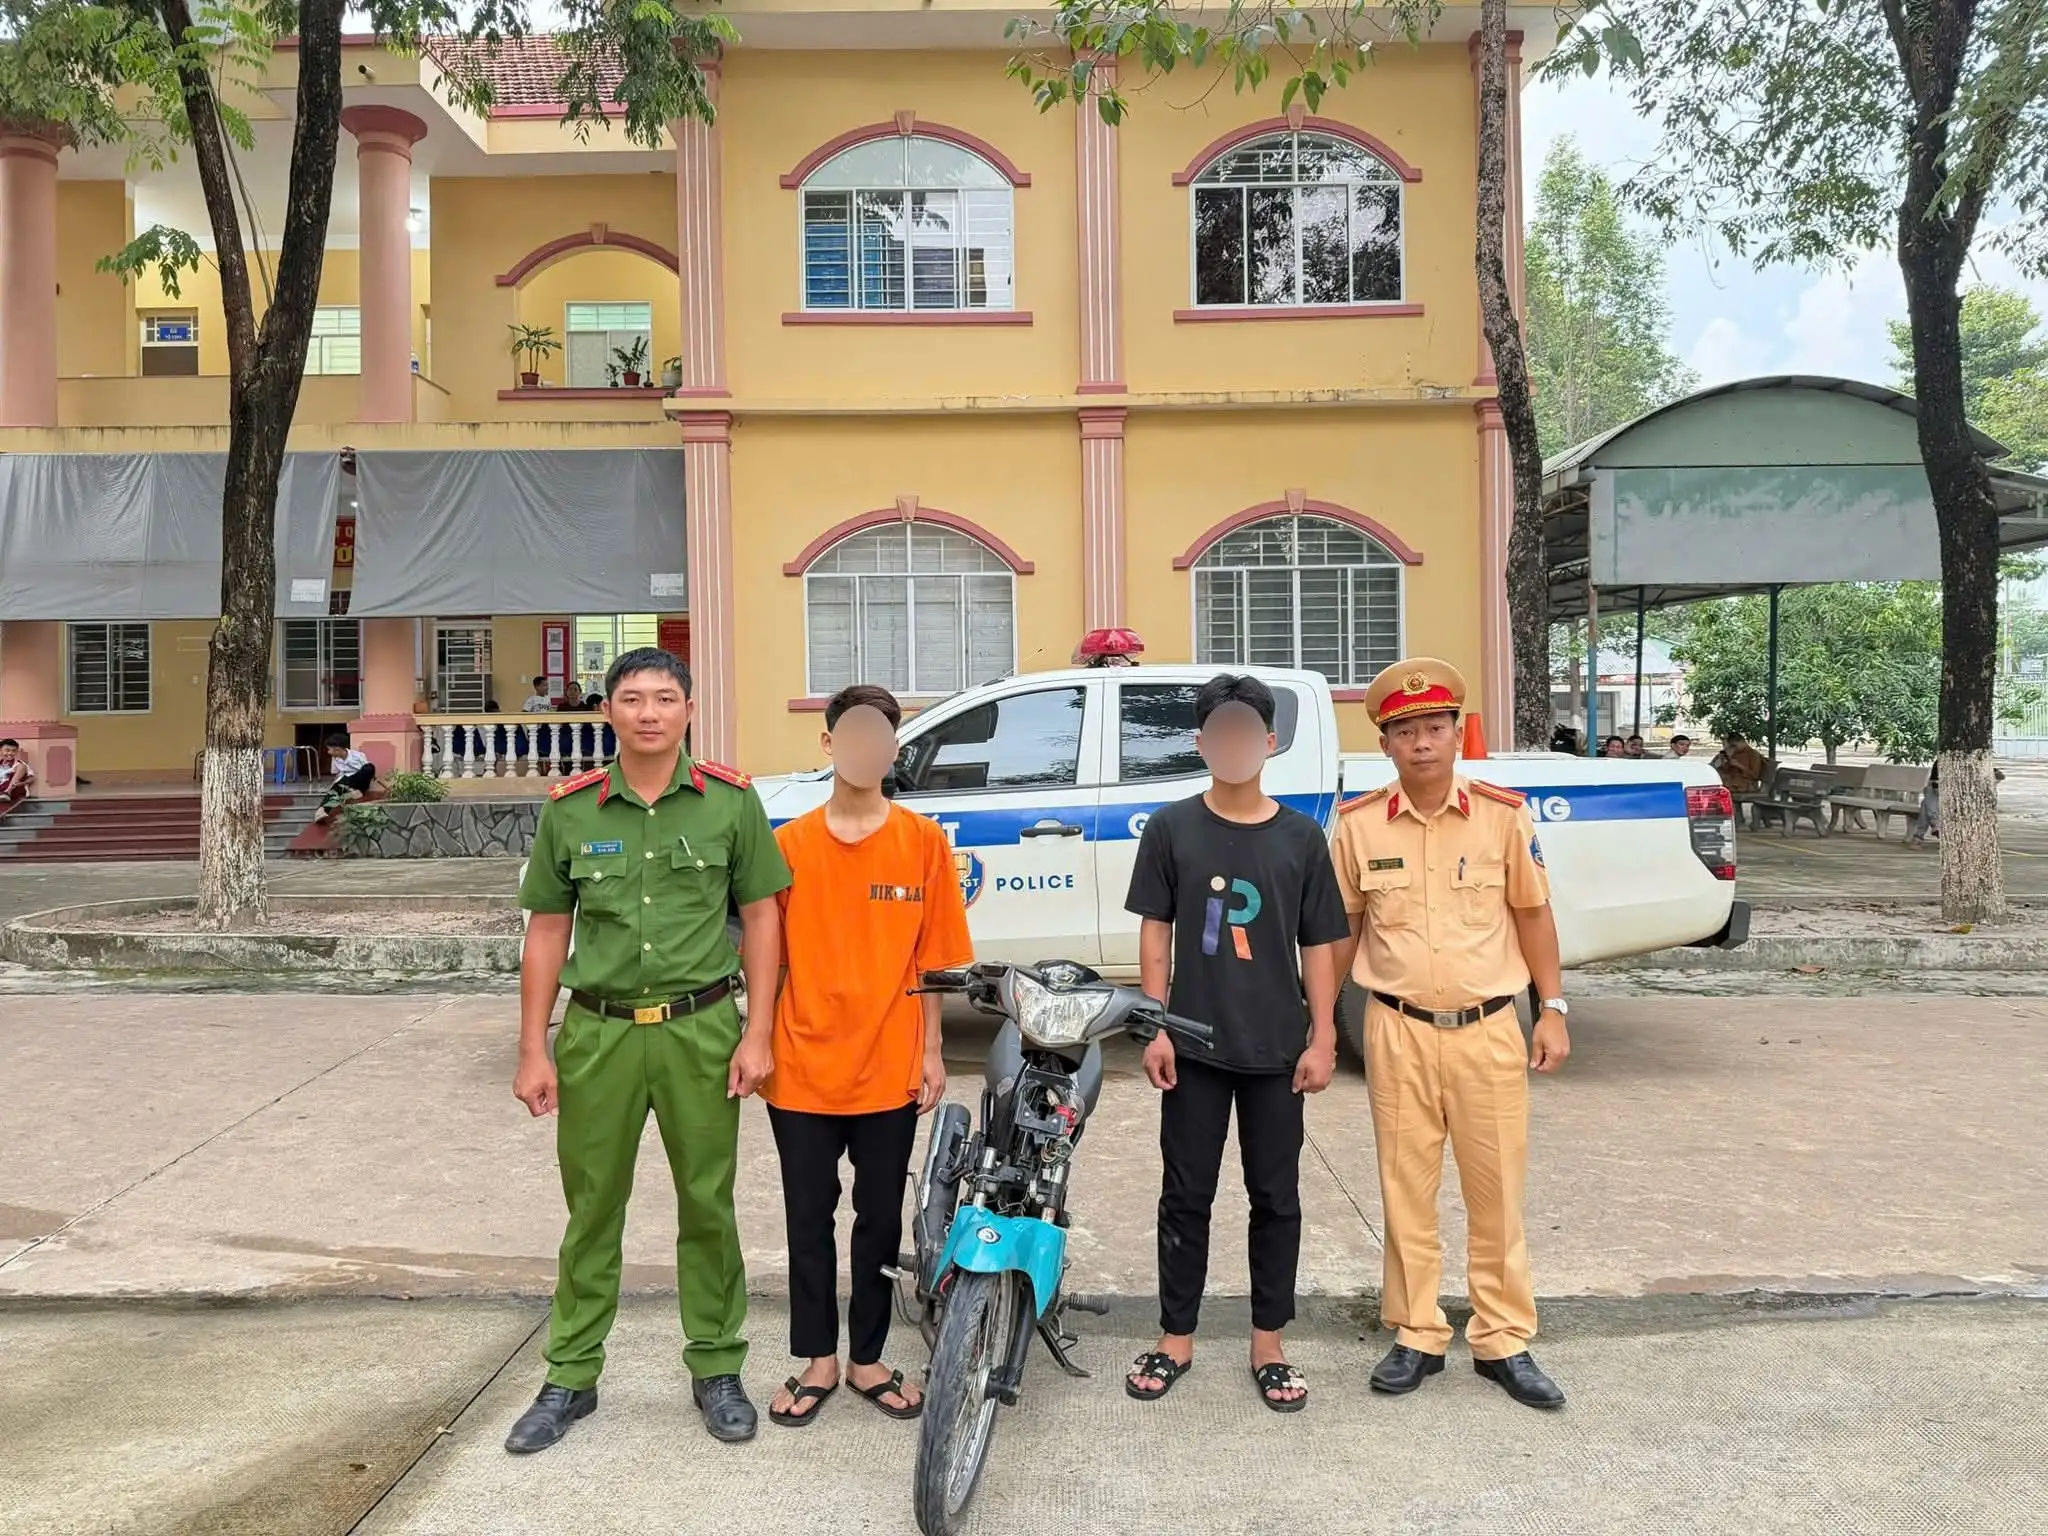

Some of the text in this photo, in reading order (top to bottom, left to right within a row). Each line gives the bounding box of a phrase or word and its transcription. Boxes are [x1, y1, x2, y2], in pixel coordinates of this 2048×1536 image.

[1128, 812, 1150, 838] G
[963, 878, 980, 887] GT
[996, 875, 1074, 891] POLICE
